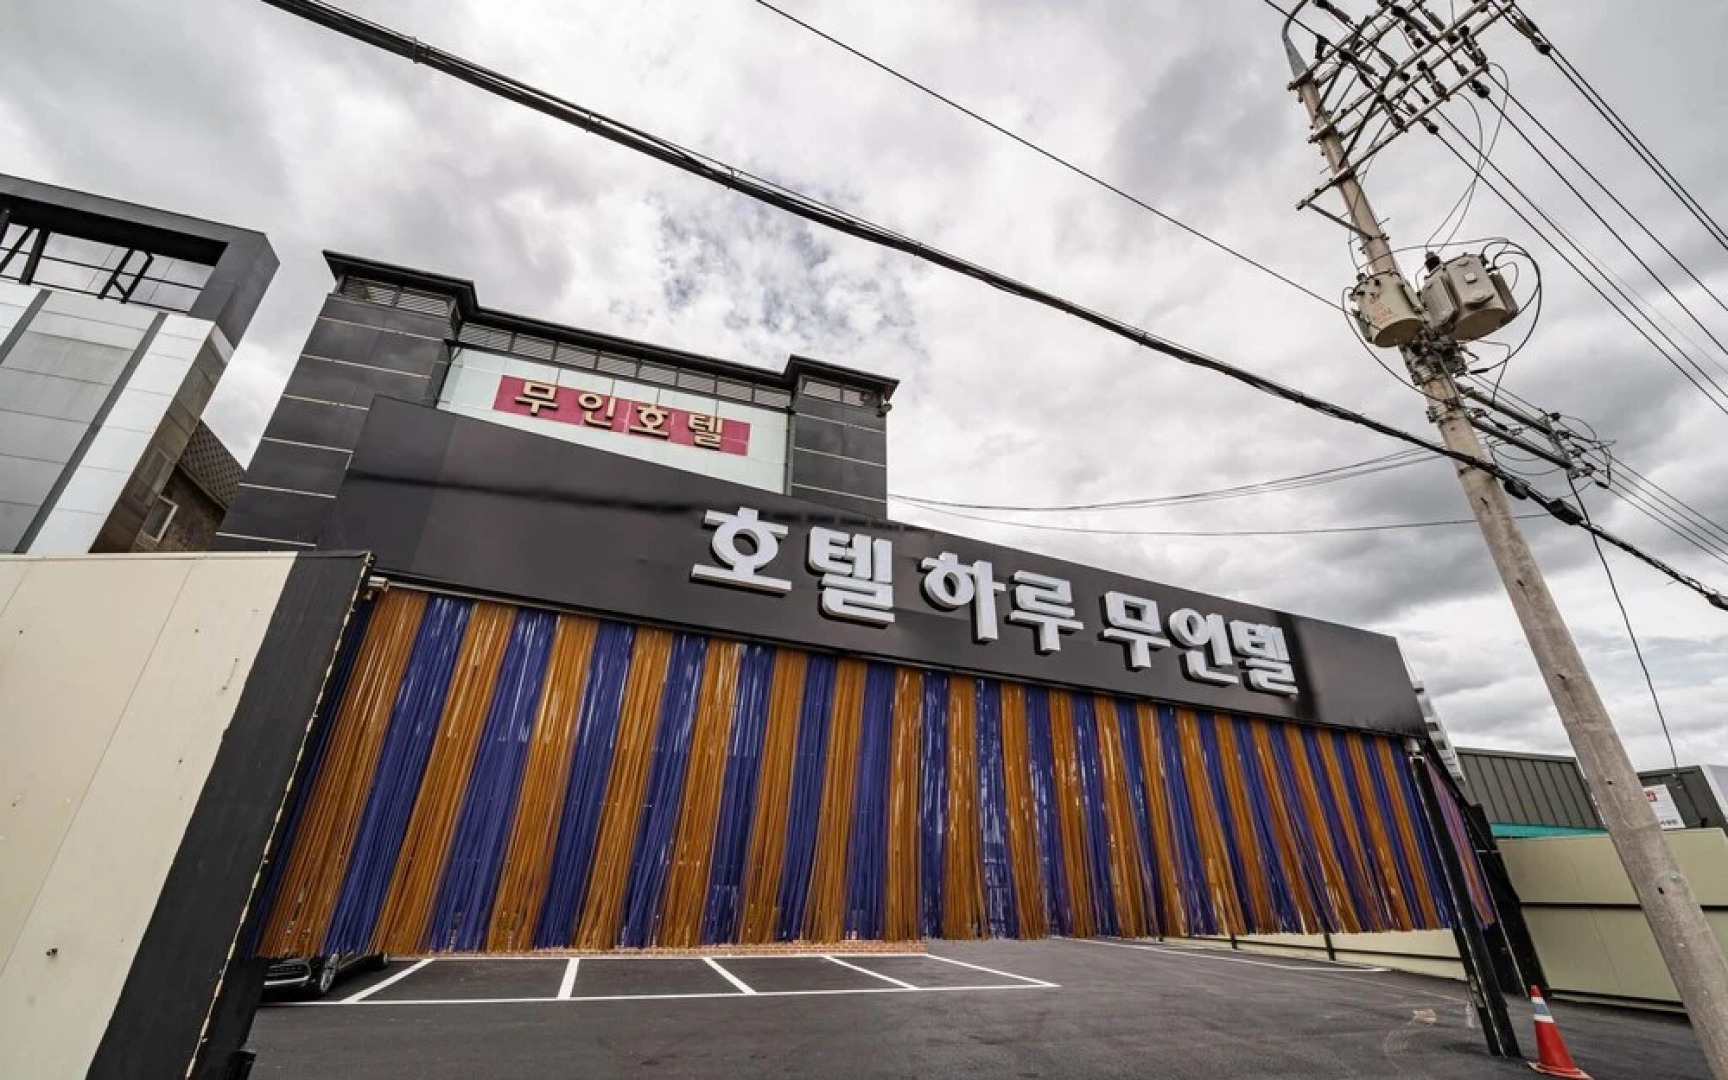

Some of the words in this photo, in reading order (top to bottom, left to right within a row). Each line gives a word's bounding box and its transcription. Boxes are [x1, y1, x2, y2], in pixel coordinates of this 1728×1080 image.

[515, 381, 723, 449] 무인호텔
[691, 507, 895, 624] 호텔
[920, 552, 1084, 651] 하루
